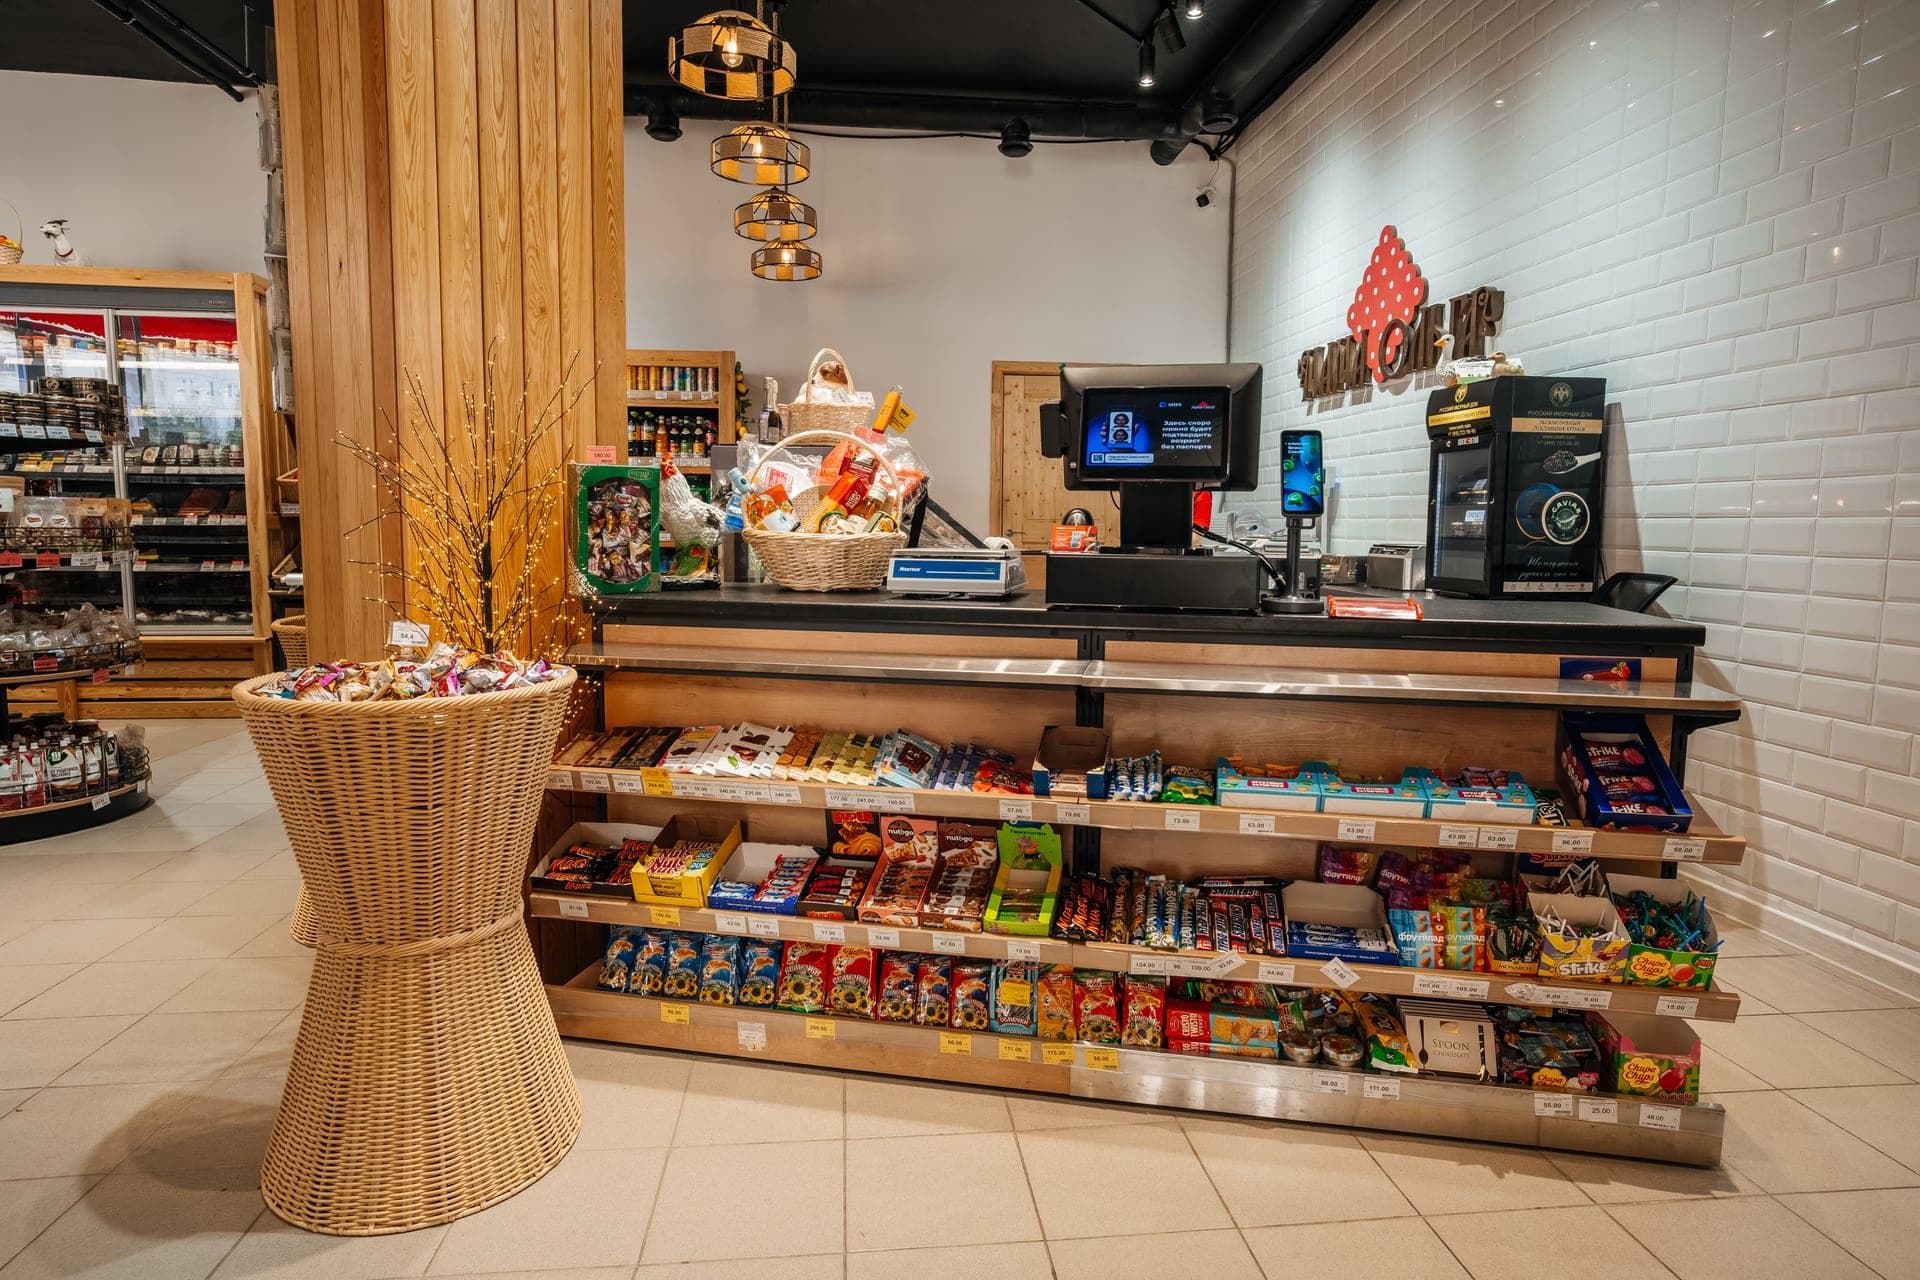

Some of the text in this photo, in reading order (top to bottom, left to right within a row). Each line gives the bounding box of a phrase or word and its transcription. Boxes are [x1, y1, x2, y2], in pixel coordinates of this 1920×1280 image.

[1636, 957, 1668, 969] Chupa
[1633, 963, 1665, 977] Chups
[1432, 1039, 1470, 1051] SPOON
[1627, 1063, 1656, 1074] Chupa
[1537, 1073, 1563, 1084] Chupa
[1625, 1071, 1654, 1083] Chups
